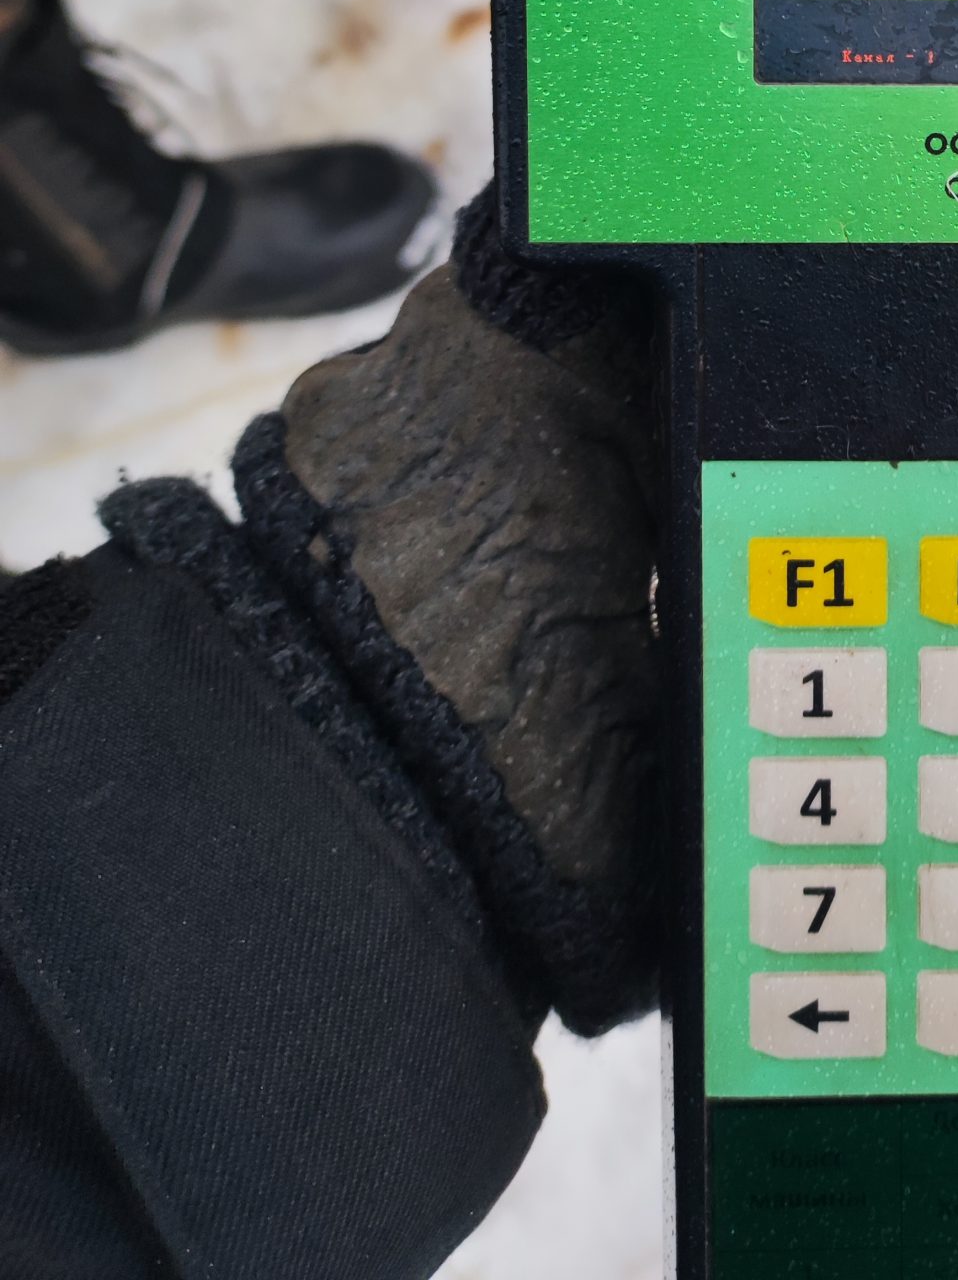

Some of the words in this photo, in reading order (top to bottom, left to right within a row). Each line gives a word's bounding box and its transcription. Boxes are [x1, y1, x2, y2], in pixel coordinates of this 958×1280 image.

[842, 49, 895, 63] Канал
[785, 558, 854, 608] F1
[802, 669, 833, 718] 1
[800, 778, 837, 826] 4
[802, 886, 836, 934] 7
